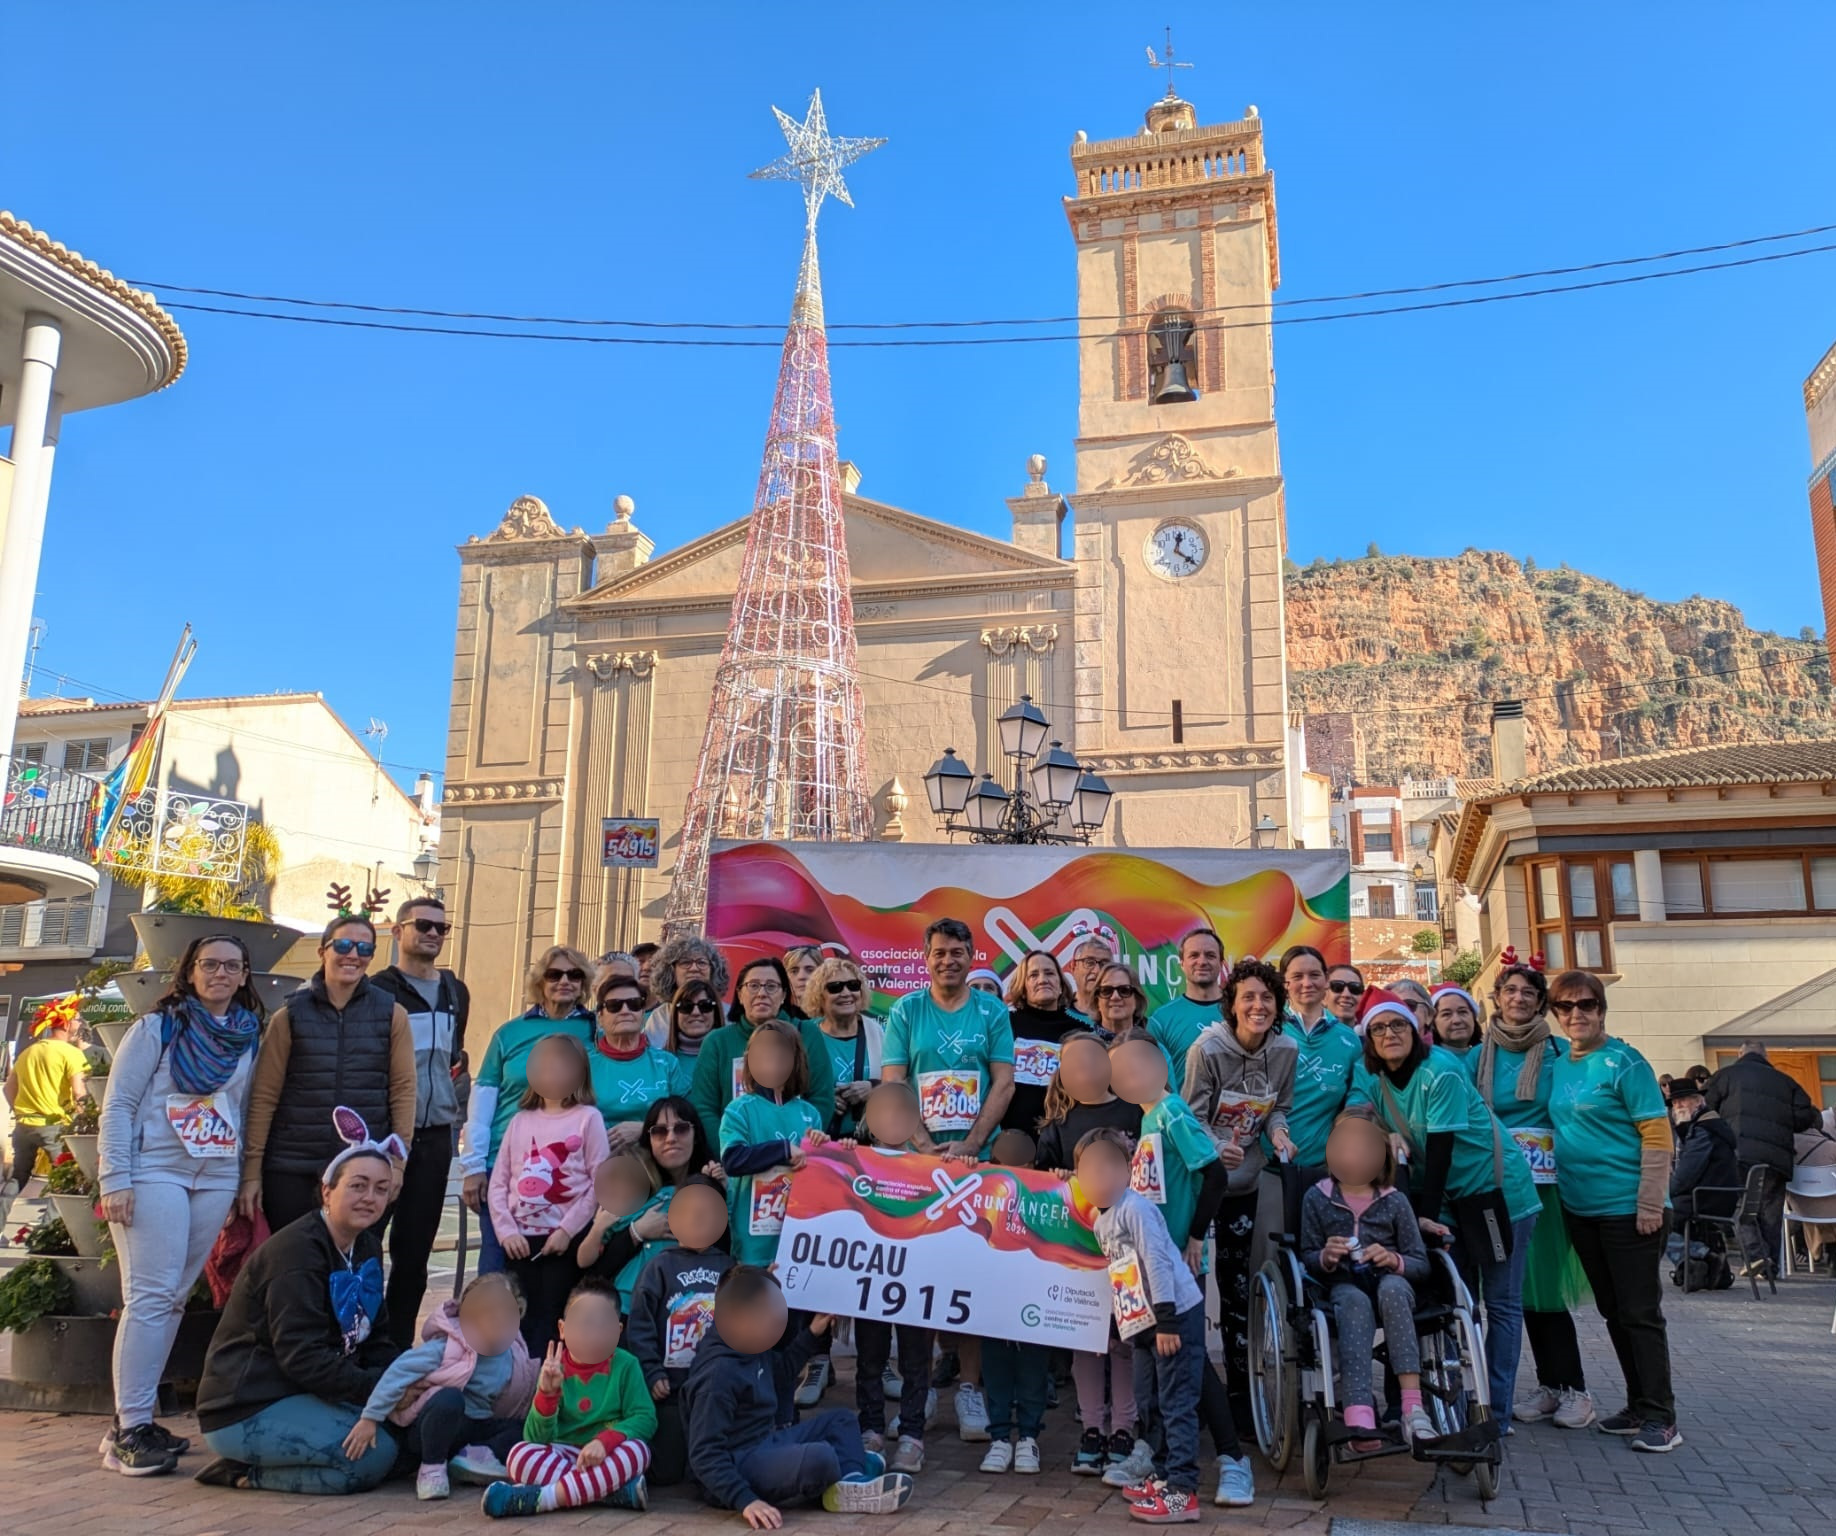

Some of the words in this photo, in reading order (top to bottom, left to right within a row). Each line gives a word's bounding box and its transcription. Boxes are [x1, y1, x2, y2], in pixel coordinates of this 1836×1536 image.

[607, 838, 654, 856] 54915
[860, 964, 901, 974] contra
[903, 964, 914, 974] el
[878, 977, 931, 989] Valencia
[1015, 1055, 1059, 1075] 5495
[923, 1091, 978, 1118] 54808
[1006, 1222, 1027, 1235] 2024
[791, 1232, 907, 1277] OLOCAU
[856, 1276, 972, 1325] 1915
